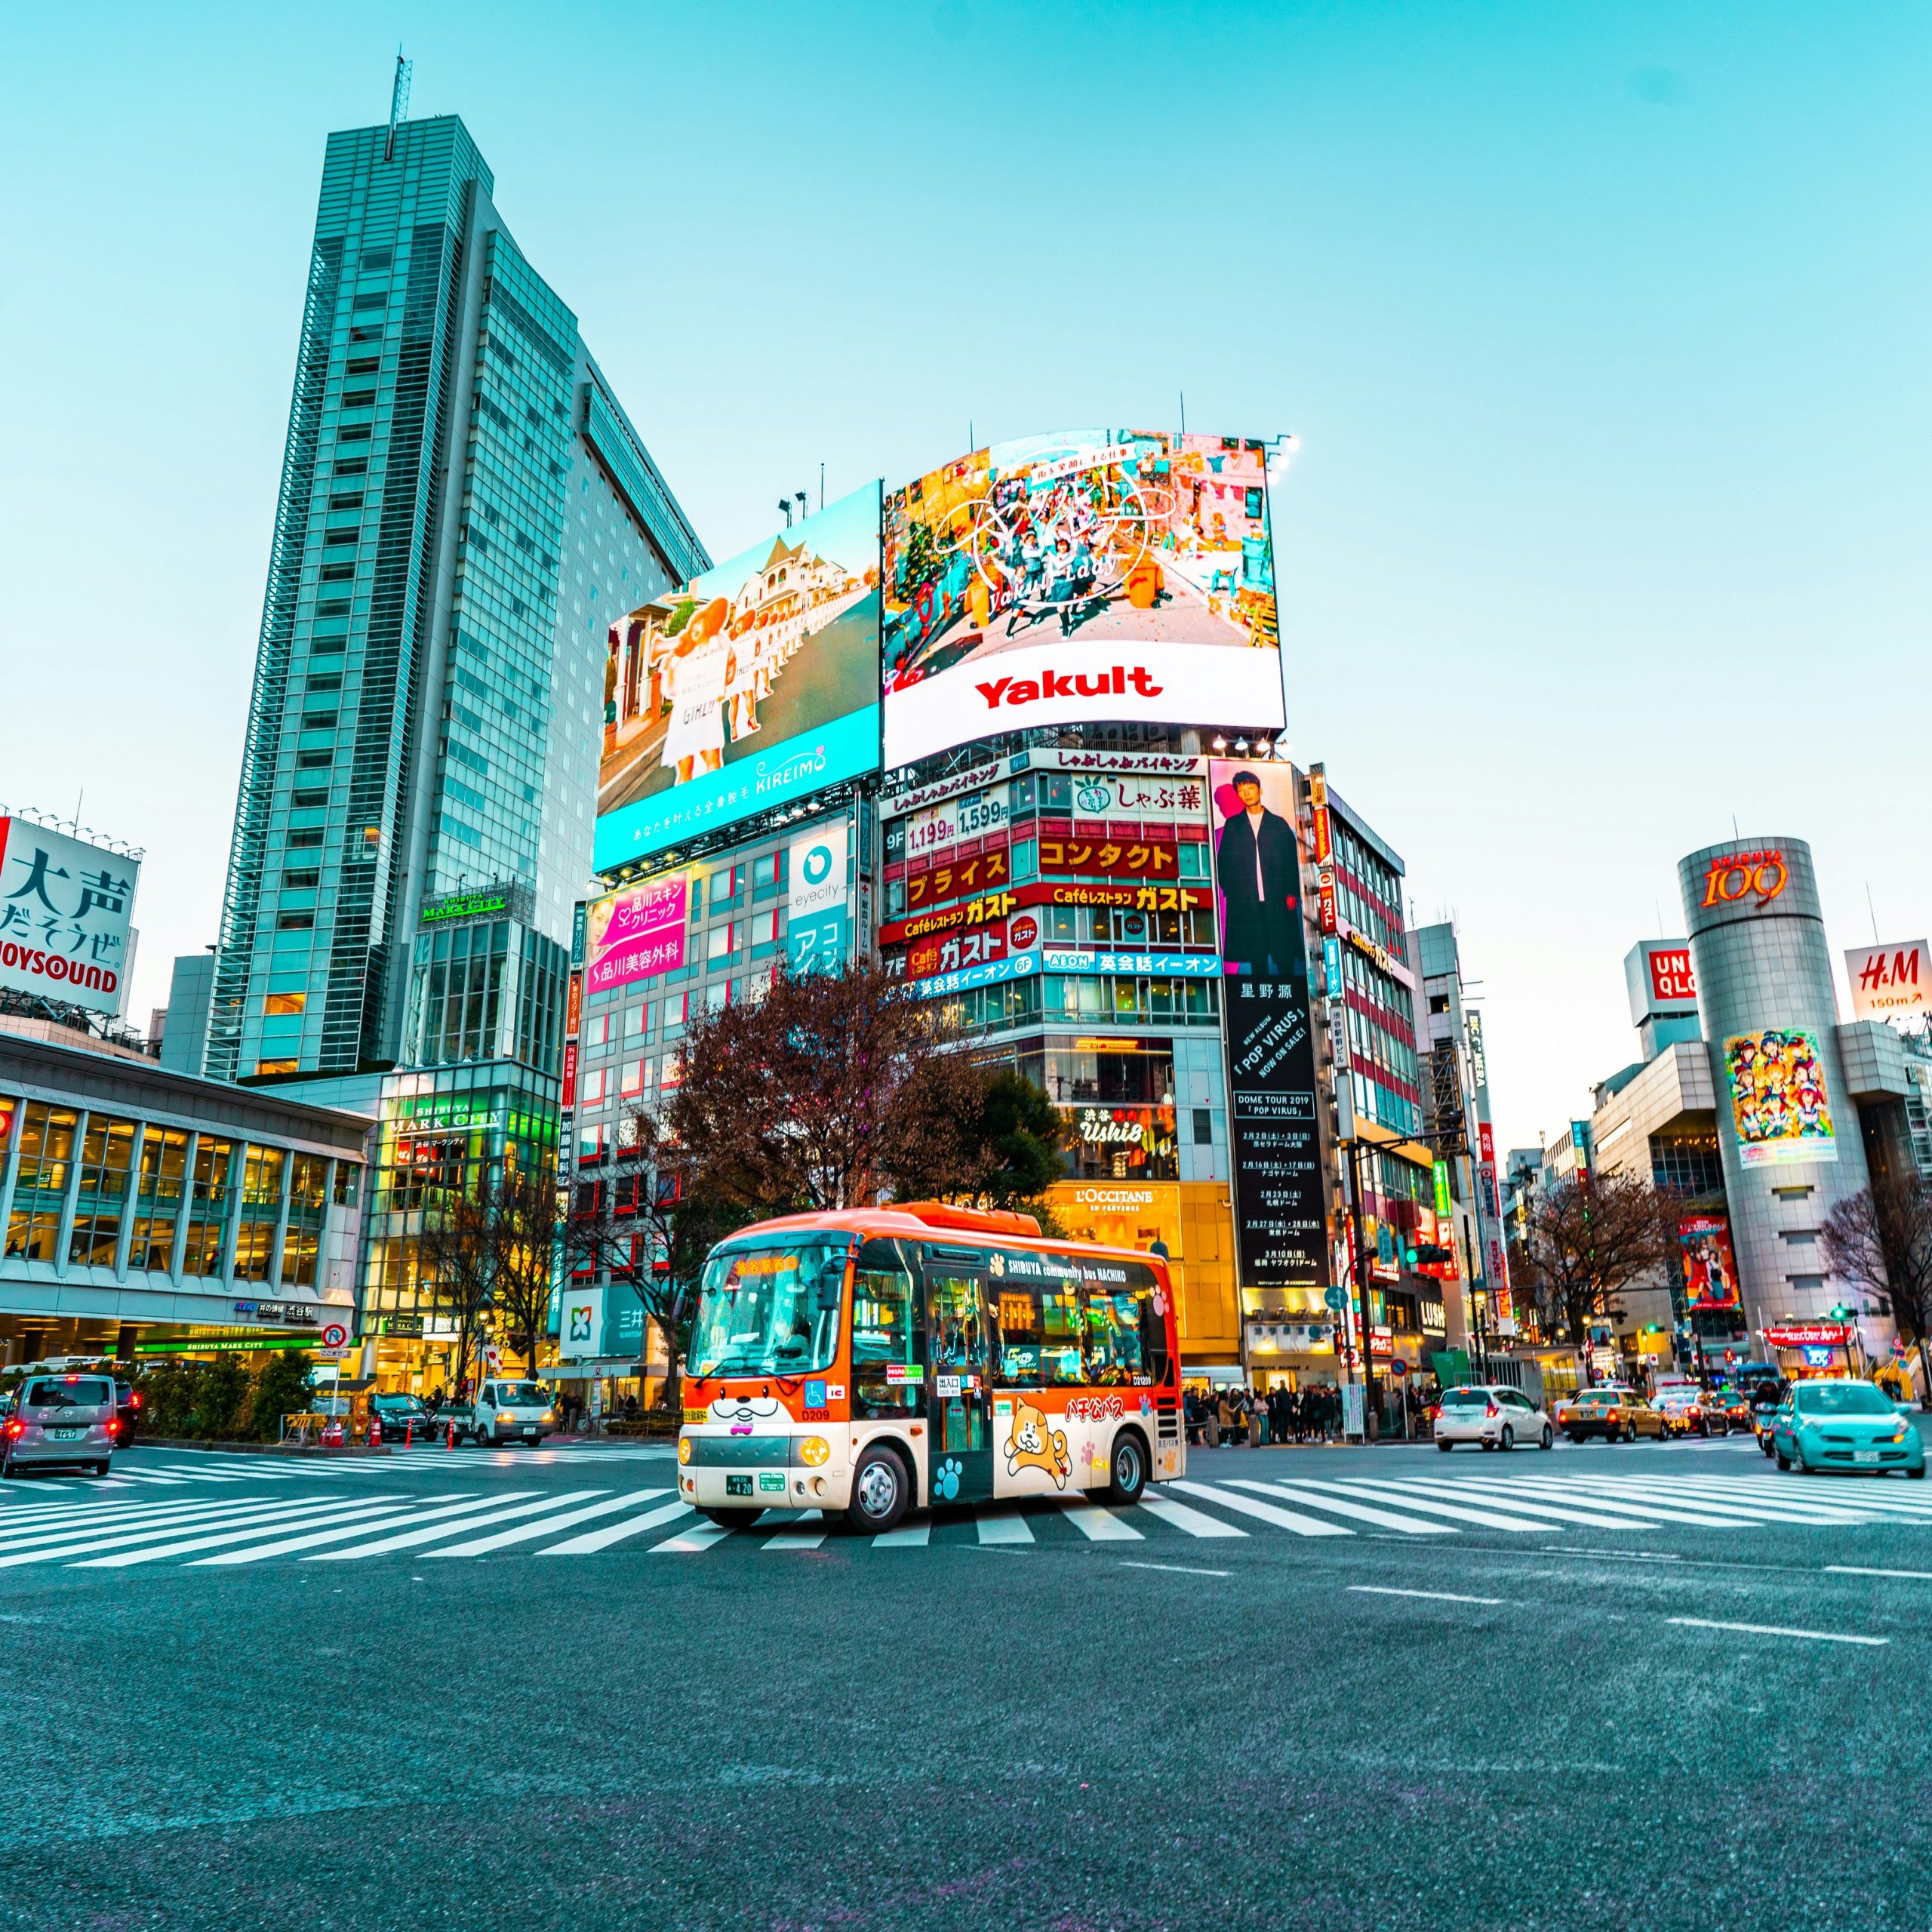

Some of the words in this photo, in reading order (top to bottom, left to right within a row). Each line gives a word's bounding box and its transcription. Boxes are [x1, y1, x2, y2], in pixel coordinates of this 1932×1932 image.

[975, 666, 1163, 709] Yakult
[1058, 752, 1199, 772] しゃぶしゃぶバイキング
[634, 786, 750, 841] あなたを叶える全身脱毛
[756, 754, 826, 795] KIREIMO
[894, 764, 999, 811] しゃぶしゃぶバイキング
[1118, 783, 1201, 811] しゃぶ葉
[887, 832, 904, 850] 9F
[1041, 842, 1173, 870] コンタクト
[1712, 851, 1782, 870] SHIBUYA
[4, 848, 131, 918] 大声
[909, 853, 1006, 902] プライス
[1701, 861, 1788, 908] 109
[632, 883, 681, 912] 品川スキン
[795, 883, 839, 906] eyecity
[423, 903, 464, 918] MARK
[467, 897, 505, 910] CITY
[631, 903, 676, 930] クリニック
[0, 903, 121, 968] だそうぜ。
[1014, 929, 1035, 942] ガスト
[601, 940, 678, 981] 品川美容外科
[912, 947, 937, 966] Café
[940, 931, 1001, 972] ガスト
[1050, 955, 1088, 968] AEON
[884, 956, 905, 978] 7F
[1017, 960, 1031, 971] 6F
[1100, 955, 1217, 973] 英会話イーオン
[1859, 949, 1918, 991] H&M
[1241, 983, 1292, 999] 星野源
[1871, 997, 1908, 1008] 150m
[1244, 1031, 1256, 1046] NEW
[1255, 1014, 1272, 1035] ALBUM
[1469, 1015, 1479, 1035] BIC
[1334, 1012, 1344, 1063] 渋谷駅前ビル
[1258, 1058, 1277, 1079] NOW
[1275, 1047, 1287, 1061] ON
[1286, 1026, 1306, 1051] SALE!
[417, 1105, 469, 1116] SHIBUYA
[1238, 1096, 1263, 1104] DOME
[1265, 1096, 1287, 1104] TOUR
[1290, 1096, 1309, 1105] 2019
[389, 1118, 445, 1132] MARK
[454, 1112, 500, 1126] CITY
[1080, 1121, 1143, 1143] Ushi8
[432, 1138, 464, 1147] マークシティ
[558, 1121, 571, 1174] 加藤眼科
[1008, 1260, 1041, 1275] SHIBUYA
[1043, 1265, 1081, 1281] community
[1083, 1266, 1097, 1280] bus
[1097, 1268, 1127, 1283] HACHIKO
[236, 1302, 256, 1311] KEIO
[287, 1306, 314, 1317] 渋谷駅
[1421, 1301, 1445, 1328] LUSH
[939, 1377, 958, 1388] 出入口
[1133, 1376, 1152, 1386] D21209
[802, 1410, 830, 1420] D209
[1065, 1394, 1124, 1421] ハチ公バス
